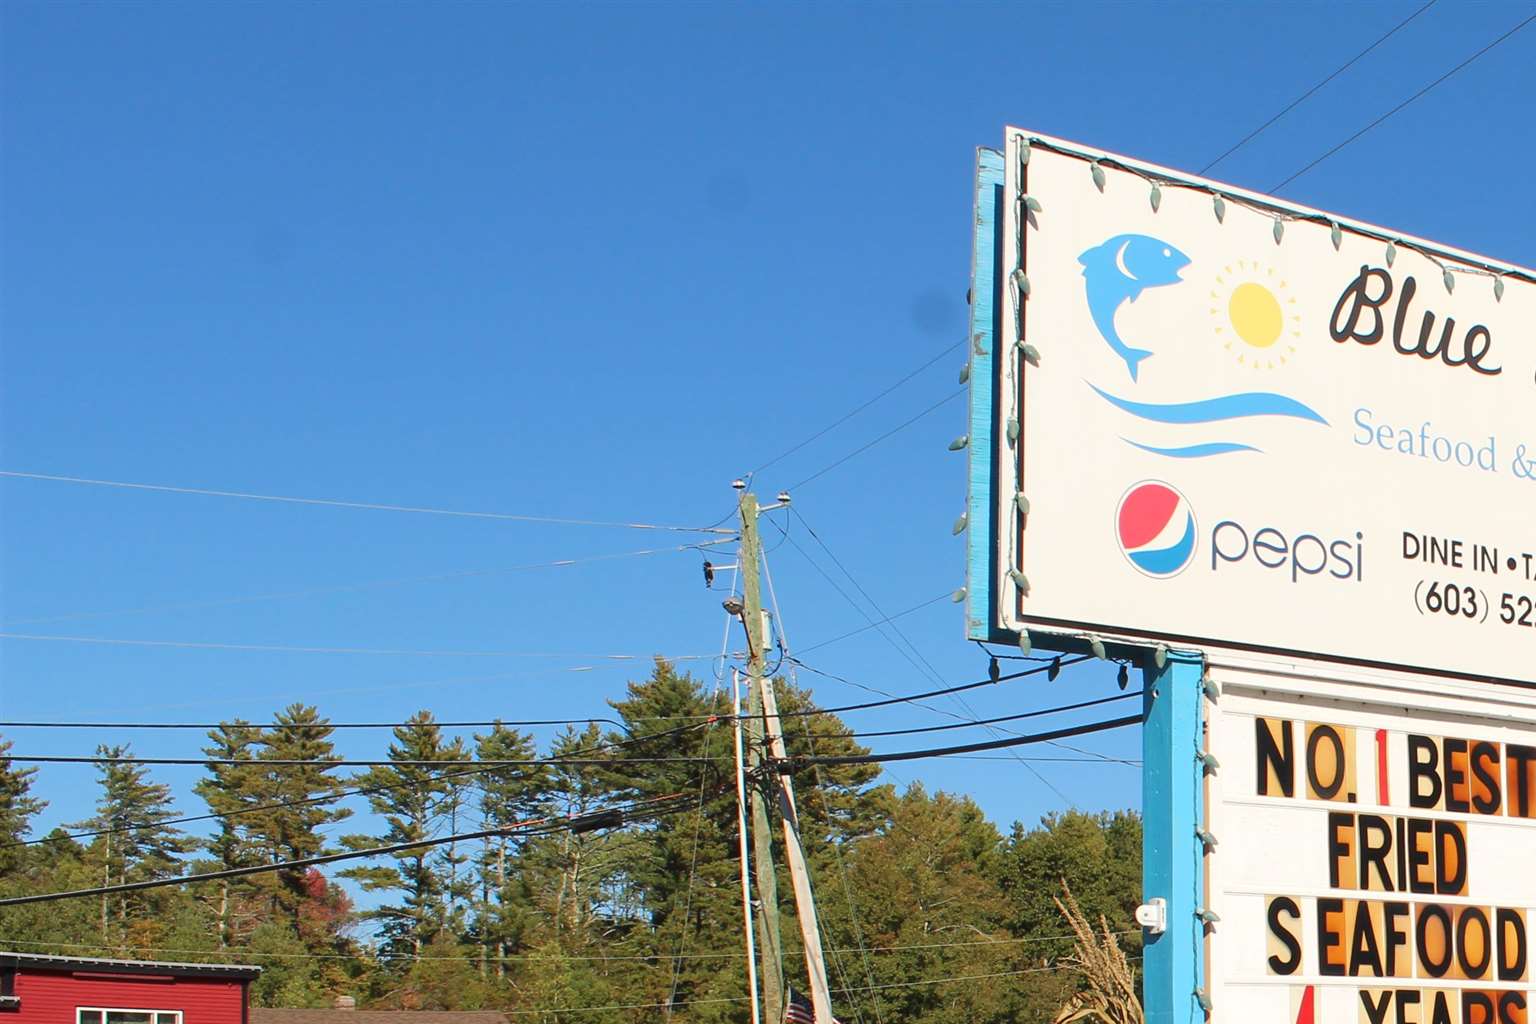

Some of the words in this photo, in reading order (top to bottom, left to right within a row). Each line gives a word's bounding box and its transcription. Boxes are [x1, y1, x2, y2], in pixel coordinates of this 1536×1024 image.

[1329, 264, 1502, 375] Blue
[1353, 408, 1497, 473] Seafood
[1211, 520, 1363, 583] pepsi
[1402, 531, 1463, 568] DINE
[1473, 544, 1498, 574] IN
[1414, 580, 1489, 624] (603)
[1255, 717, 1357, 803] NO.
[1375, 728, 1390, 806] 1
[1328, 812, 1467, 896] FRIED
[1268, 896, 1528, 982] SEAFOOD
